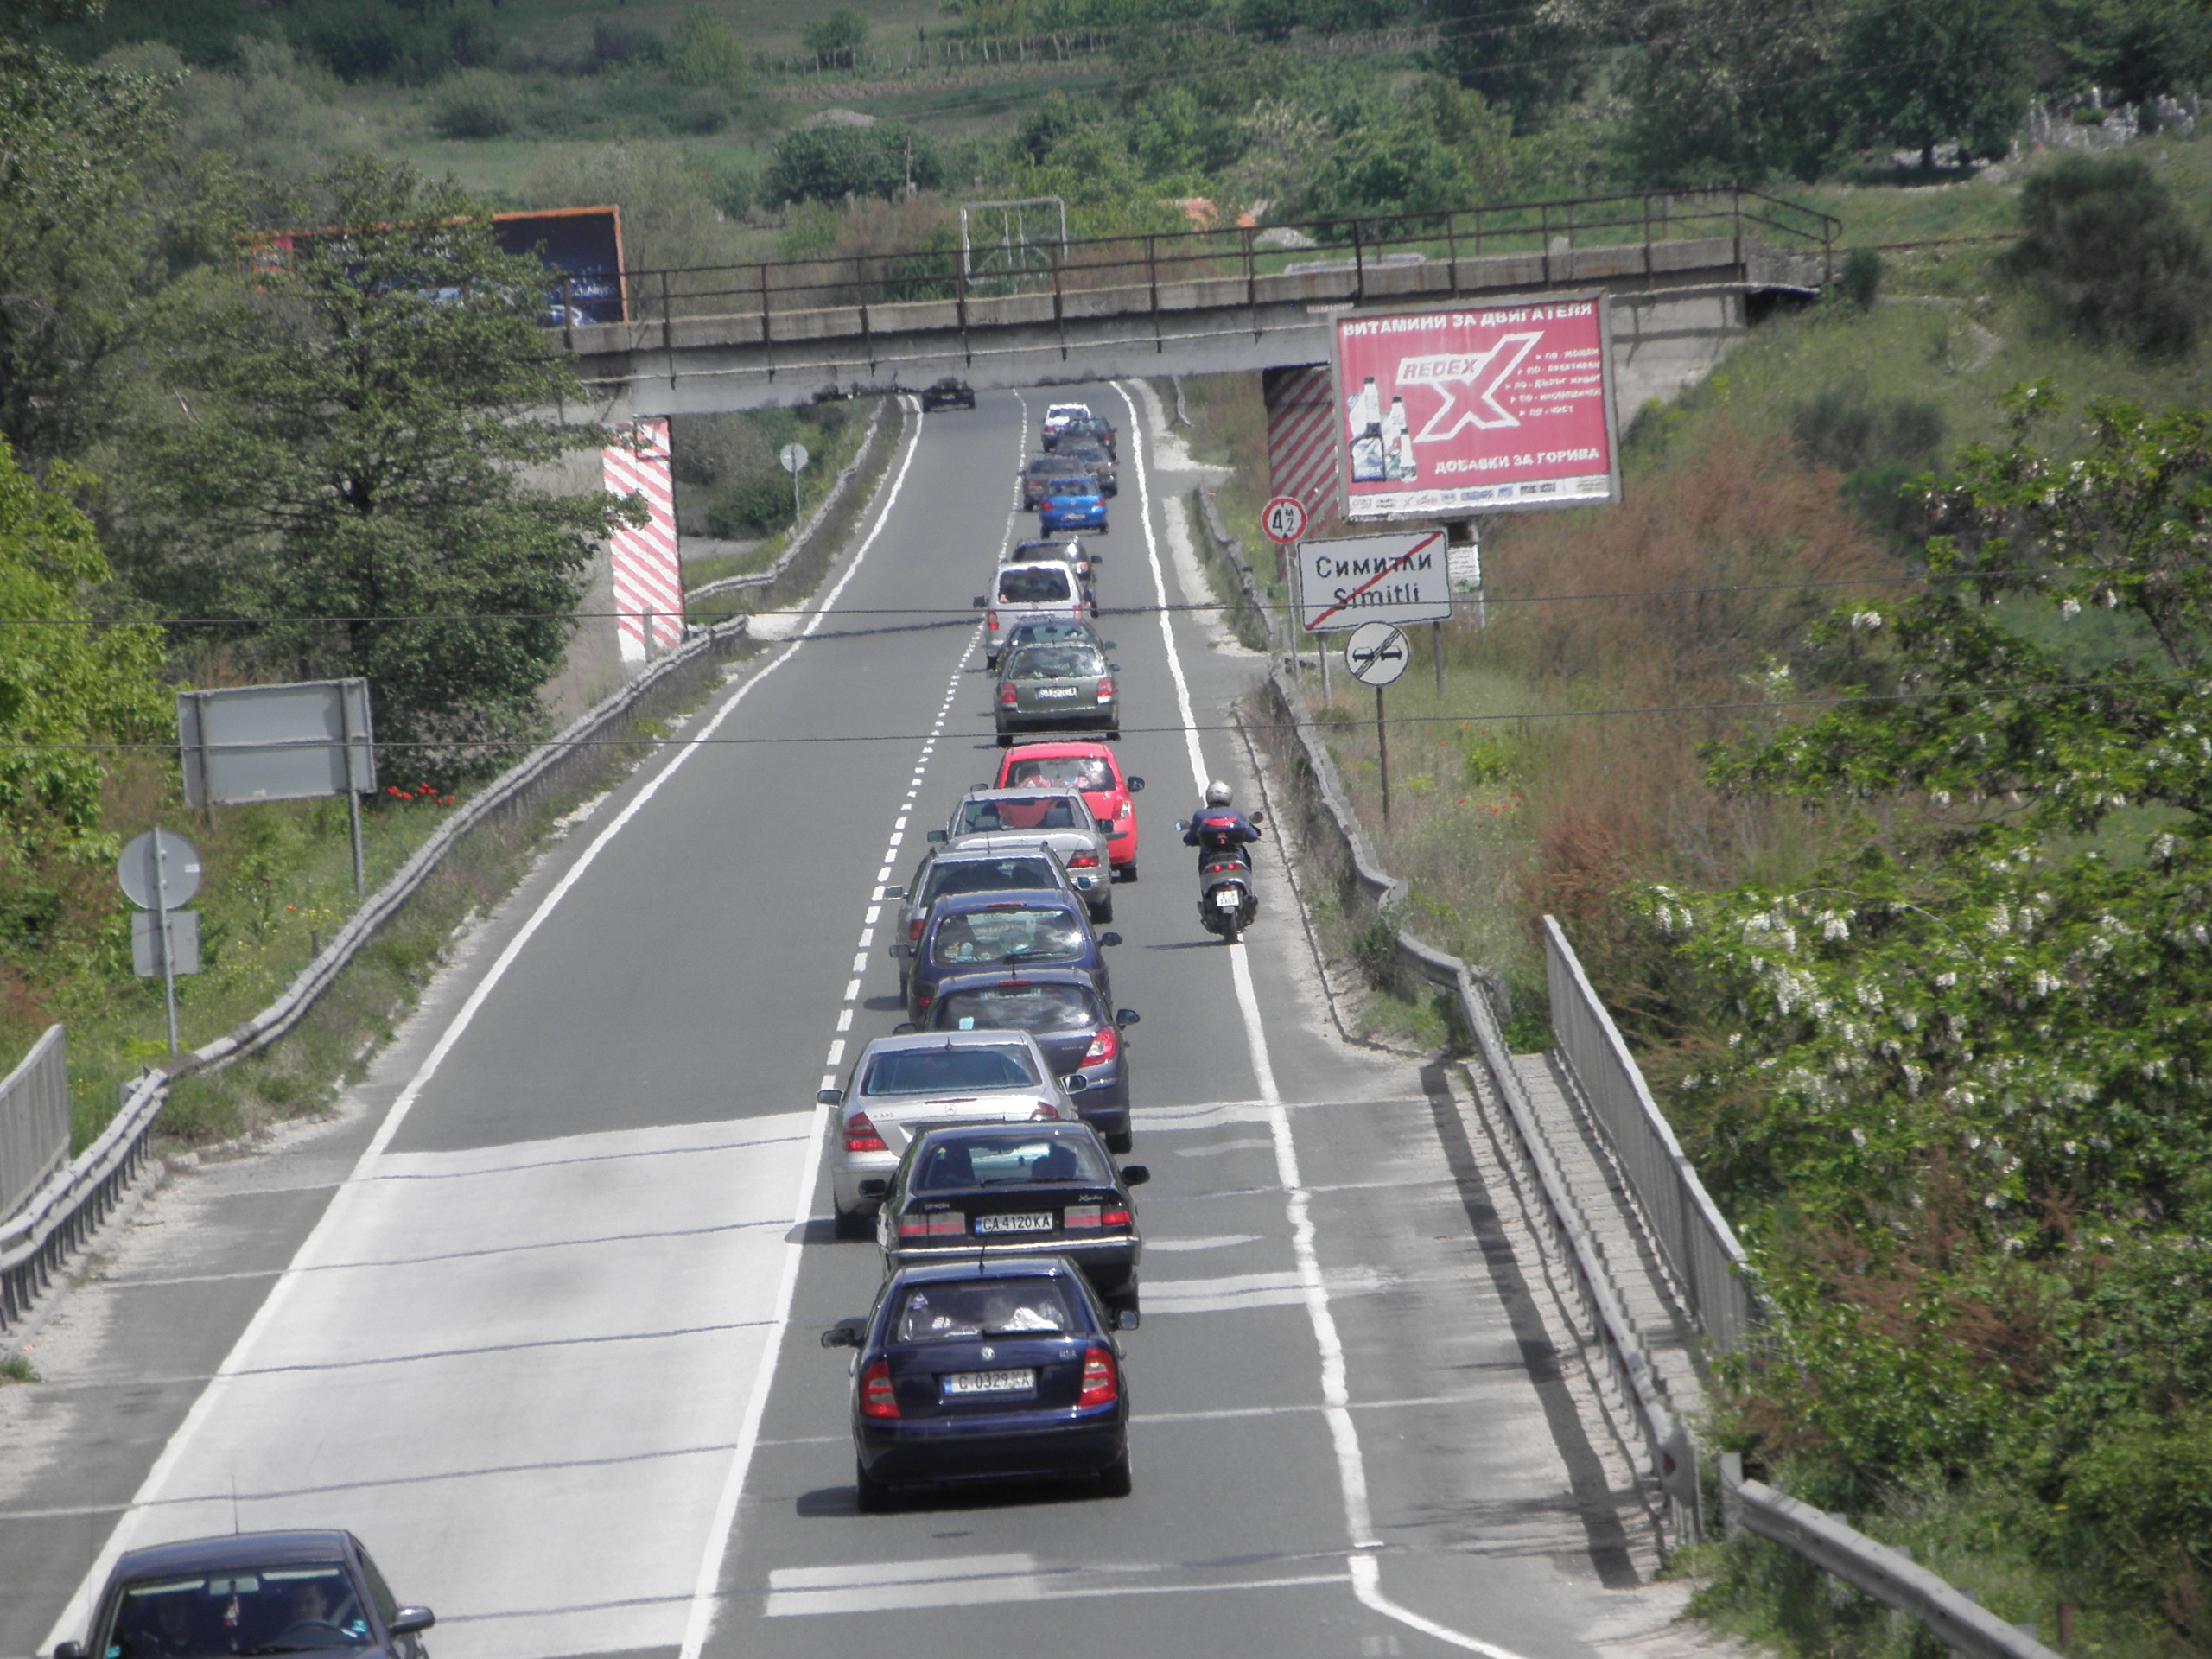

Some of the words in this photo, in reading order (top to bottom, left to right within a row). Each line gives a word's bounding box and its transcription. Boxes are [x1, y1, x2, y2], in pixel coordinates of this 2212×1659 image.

[1342, 315, 1447, 337] ВИТАМИНИ
[1452, 313, 1477, 328] ЗА
[1480, 302, 1593, 327] ДВИГАТЕЛЯ
[1402, 358, 1479, 380] REDEX
[1434, 454, 1510, 475] ДОБАВКИ
[1513, 454, 1534, 467] ЗА
[1536, 447, 1600, 465] ГОРИВА
[1315, 553, 1432, 579] Симитли
[1333, 582, 1420, 611] Simitli
